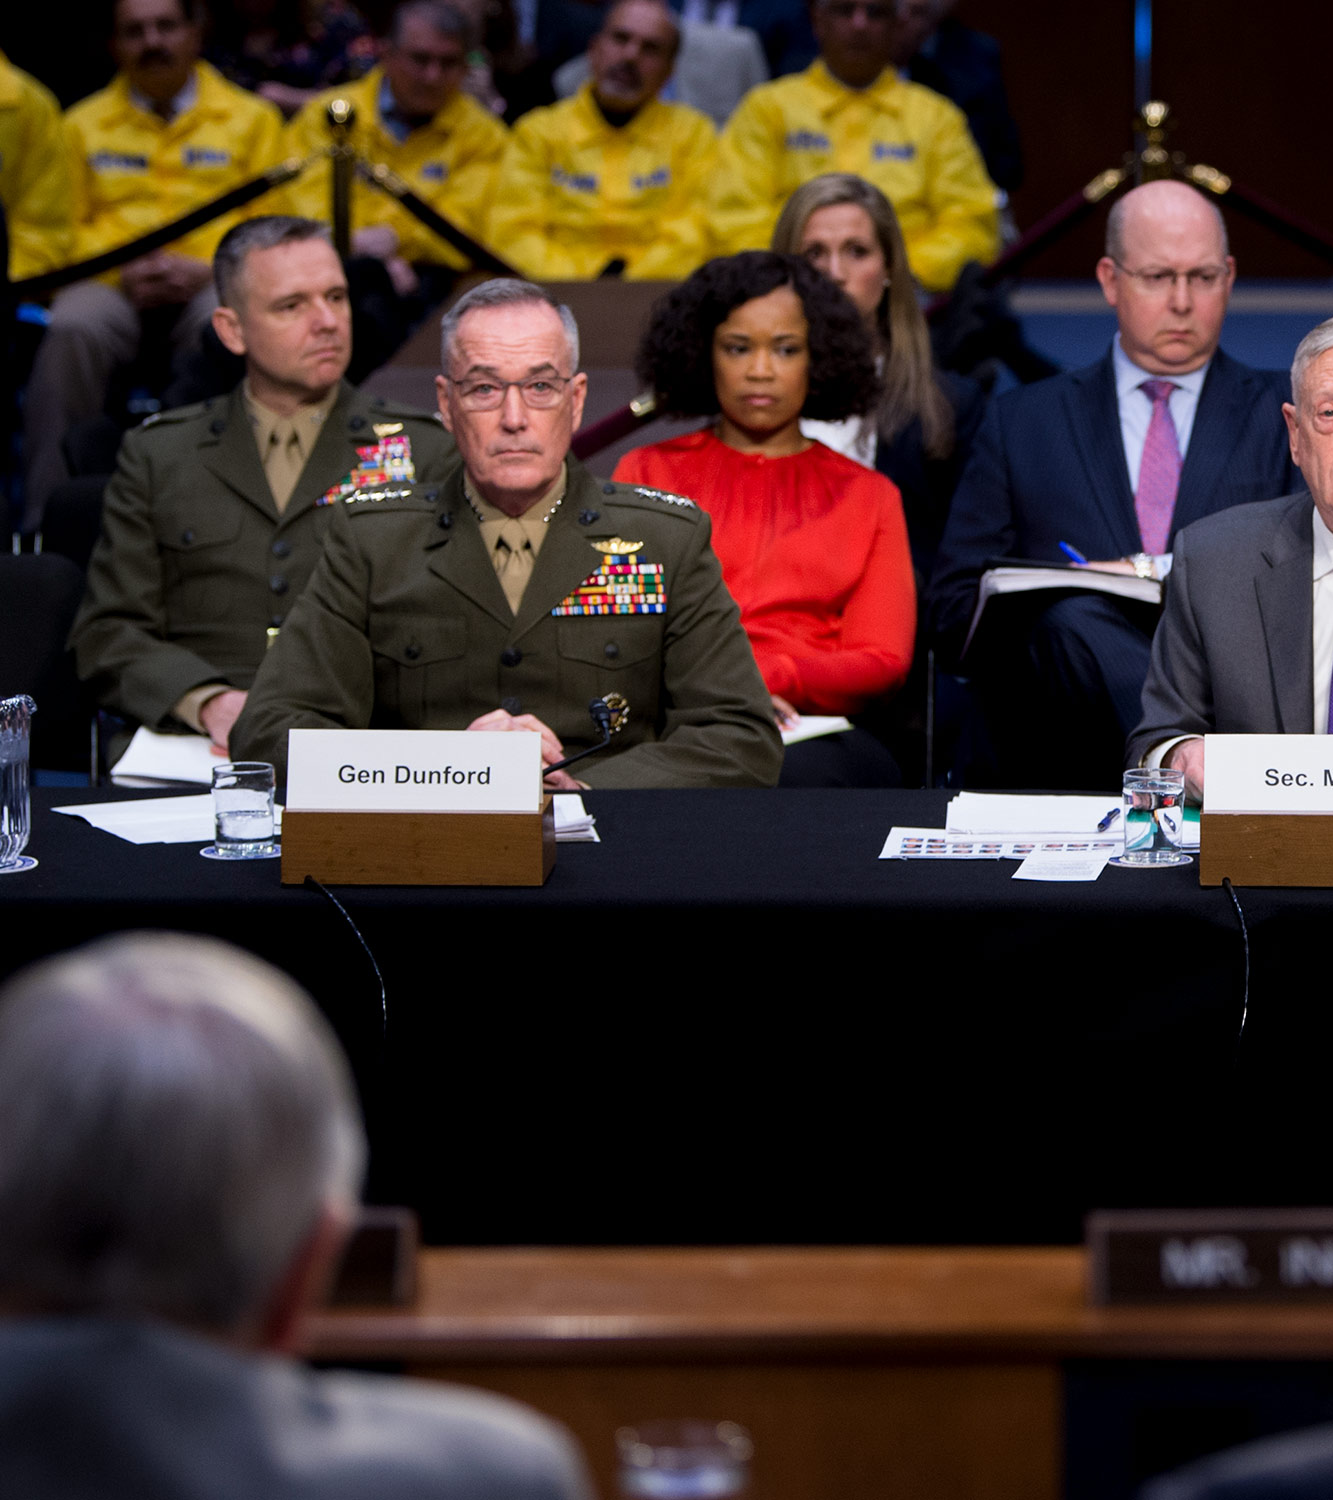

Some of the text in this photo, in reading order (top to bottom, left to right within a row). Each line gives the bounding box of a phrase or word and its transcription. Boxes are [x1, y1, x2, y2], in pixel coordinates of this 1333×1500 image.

[338, 765, 491, 785] Gen Dunford
[1264, 768, 1314, 787] Sec.
